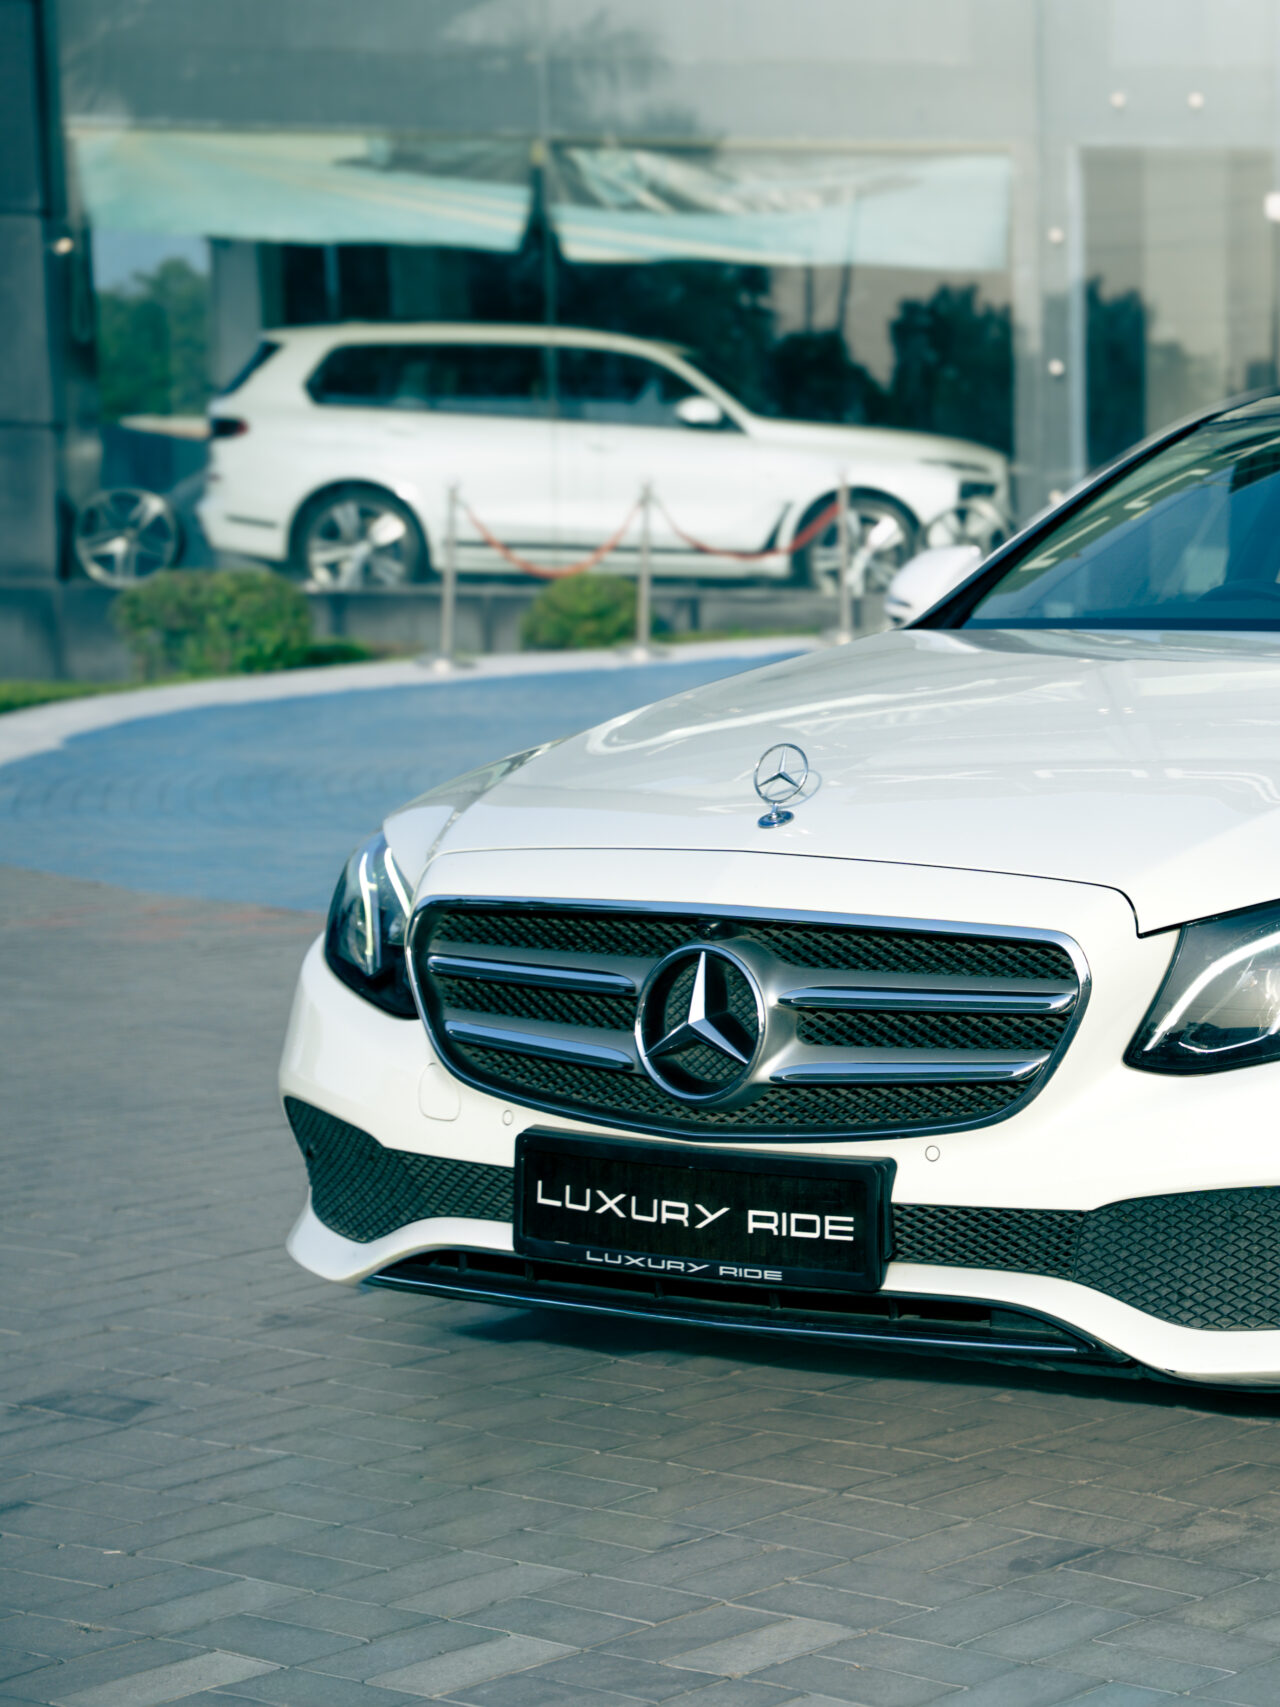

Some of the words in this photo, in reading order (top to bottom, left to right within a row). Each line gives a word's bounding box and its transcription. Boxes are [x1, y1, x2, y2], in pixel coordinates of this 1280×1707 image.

[536, 1180, 731, 1229] LUXURY
[747, 1209, 855, 1242] RIDE
[586, 1250, 710, 1273] LUXURY
[718, 1265, 783, 1281] RIDE
